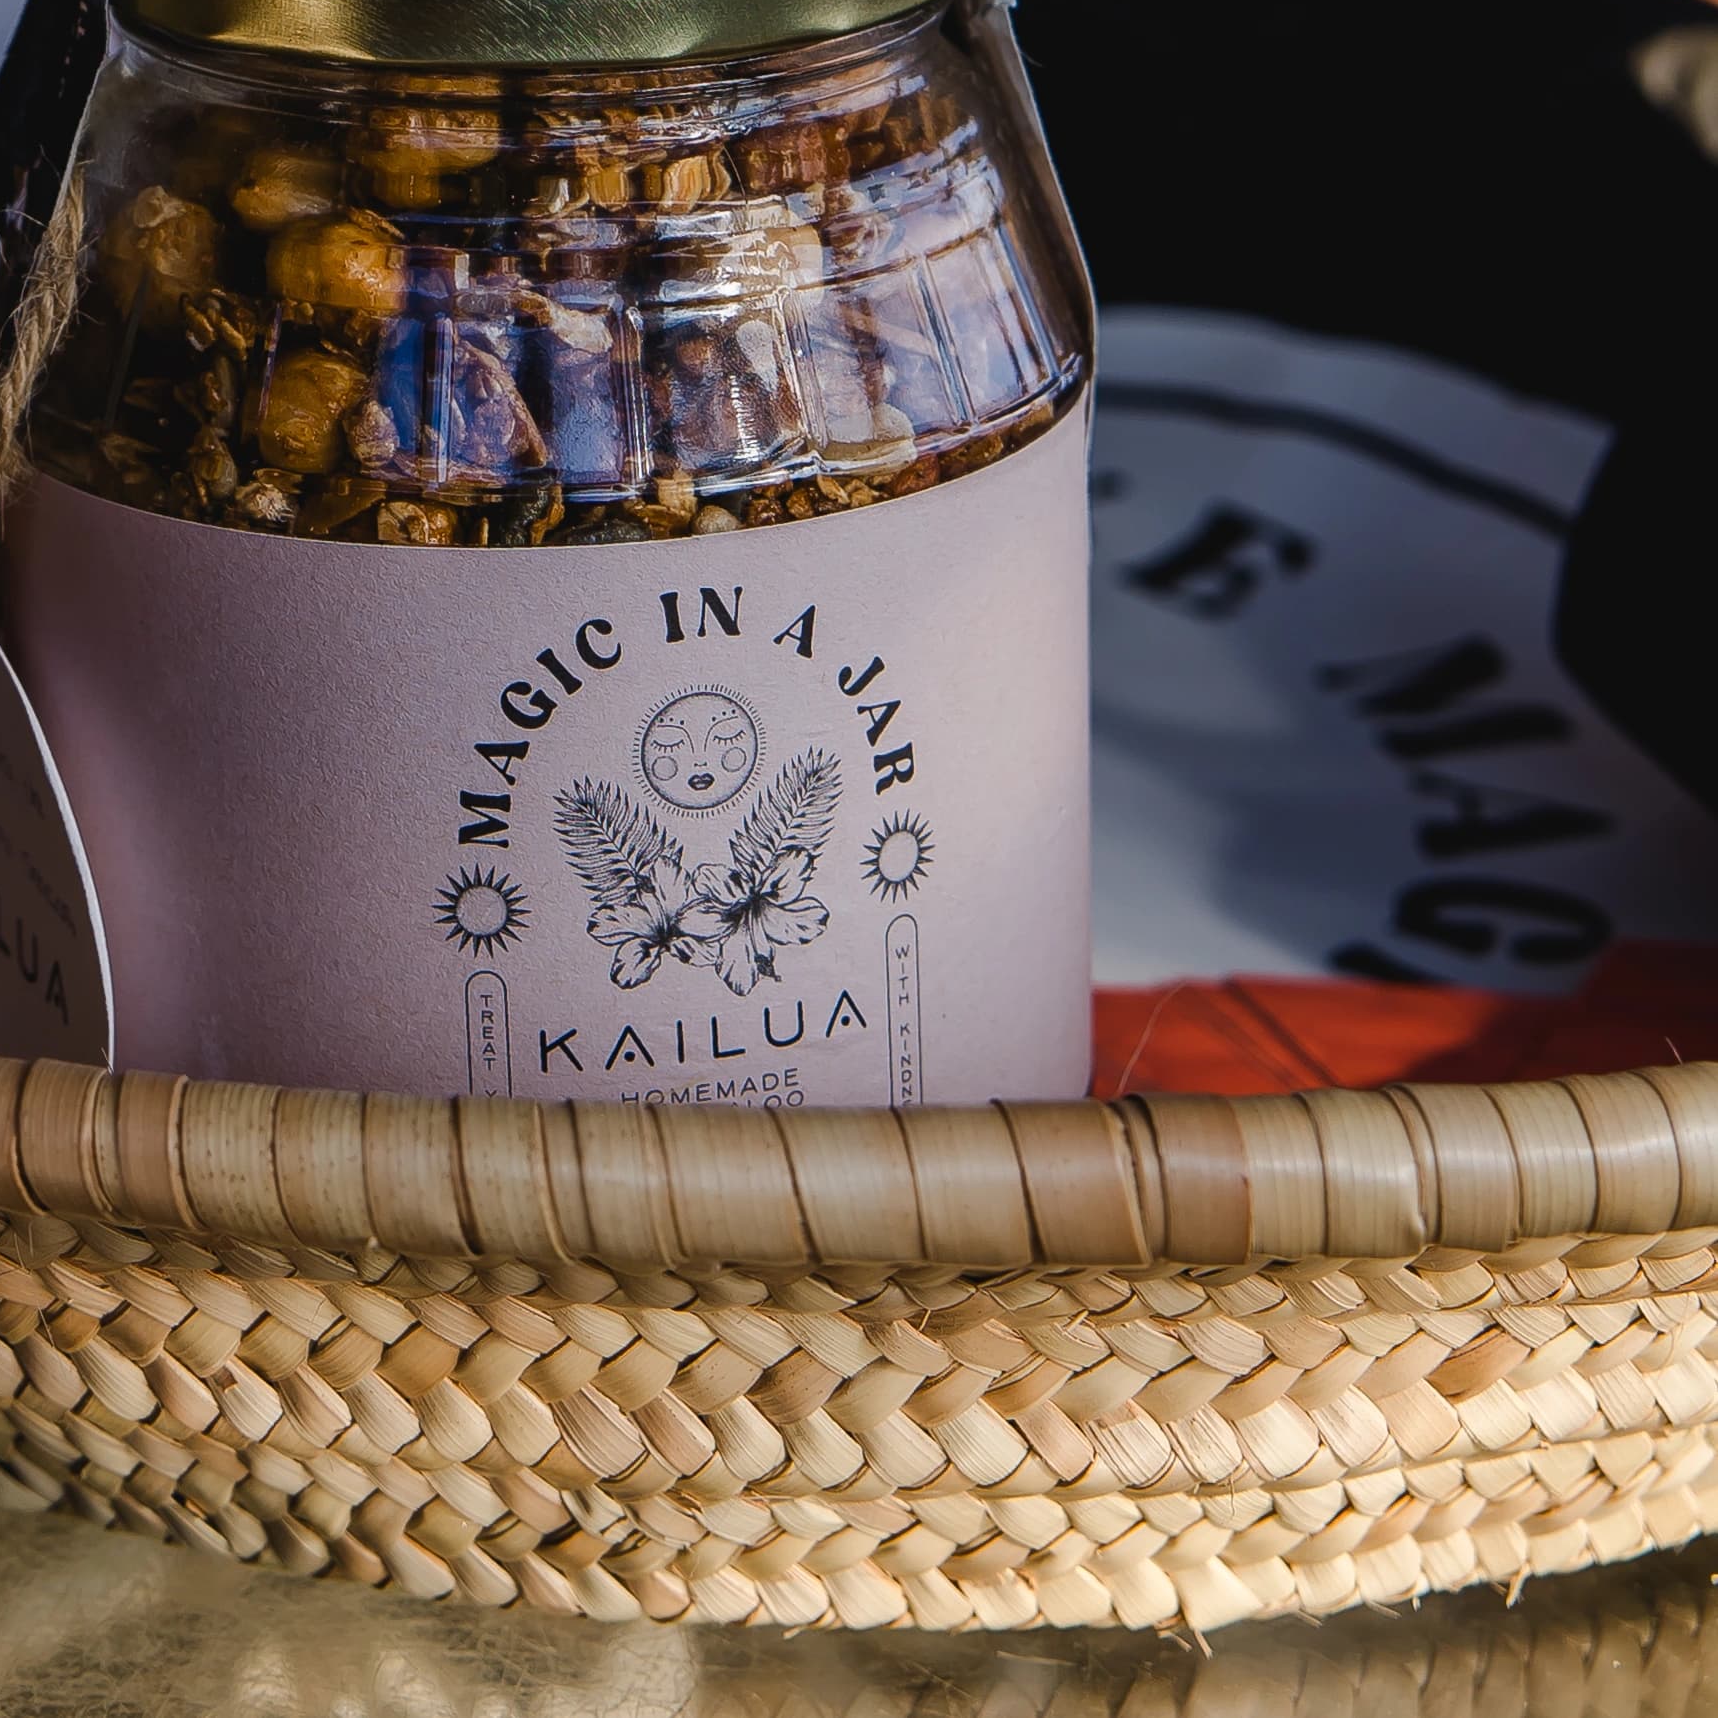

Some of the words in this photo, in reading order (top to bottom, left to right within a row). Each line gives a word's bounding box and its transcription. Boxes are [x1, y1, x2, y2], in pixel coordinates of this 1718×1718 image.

[456, 618, 622, 850] MAGIC
[659, 584, 746, 645] IN
[773, 603, 820, 659] A
[838, 654, 916, 797] JAR
[895, 944, 910, 1006] WITH
[479, 994, 497, 1071] TREAT
[537, 986, 870, 1076] KAILUA
[899, 1022, 913, 1107] KINDN
[620, 1067, 800, 1105] HOMEMADE
